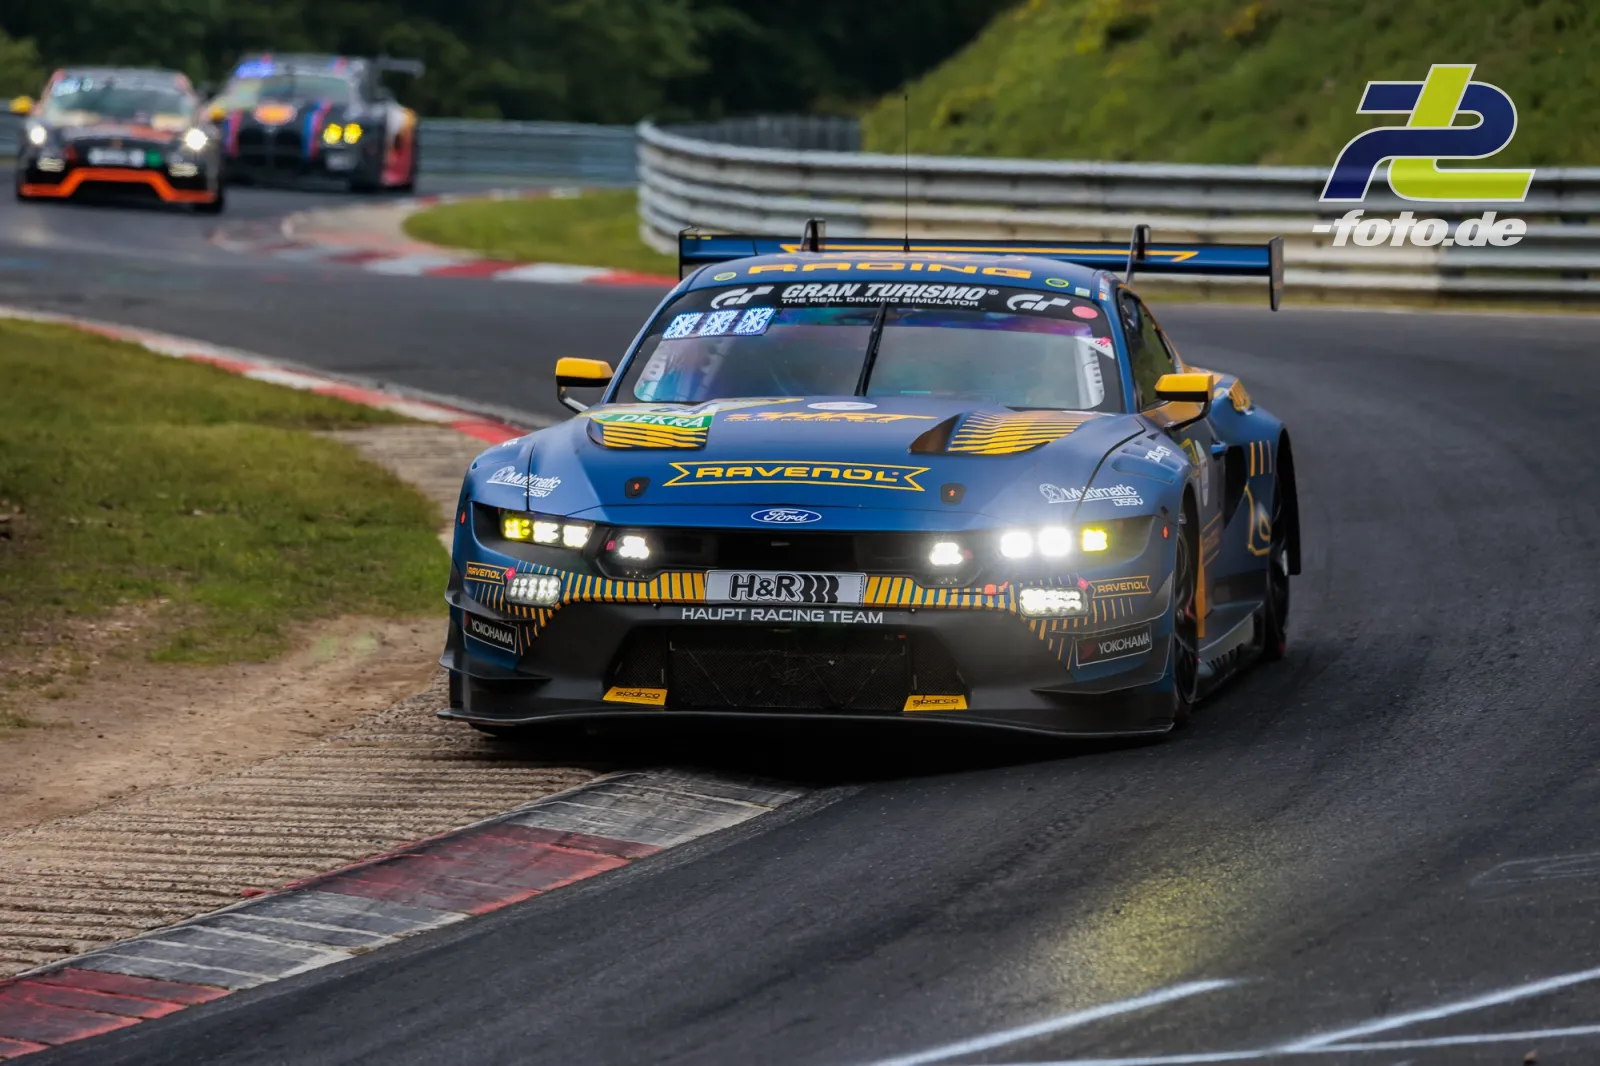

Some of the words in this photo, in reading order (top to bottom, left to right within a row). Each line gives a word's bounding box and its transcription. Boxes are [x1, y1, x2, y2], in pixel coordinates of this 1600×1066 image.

[781, 283, 861, 298] GRAN
[902, 297, 979, 307] SIMULATOR
[616, 414, 704, 428] DEKRA
[695, 466, 898, 483] RAVENOL
[1061, 484, 1138, 501] Multimatic
[763, 509, 809, 522] Ford
[467, 566, 502, 579] RAVENOL
[730, 574, 799, 600] H&R
[1097, 580, 1146, 593] RAVENOL
[681, 608, 747, 621] HAUPT
[750, 609, 825, 622] RACING
[829, 610, 884, 624] TEAM
[470, 618, 513, 645] YOKOHAMA
[1098, 632, 1150, 654] YOKOHAMA
[615, 691, 661, 699] sparco
